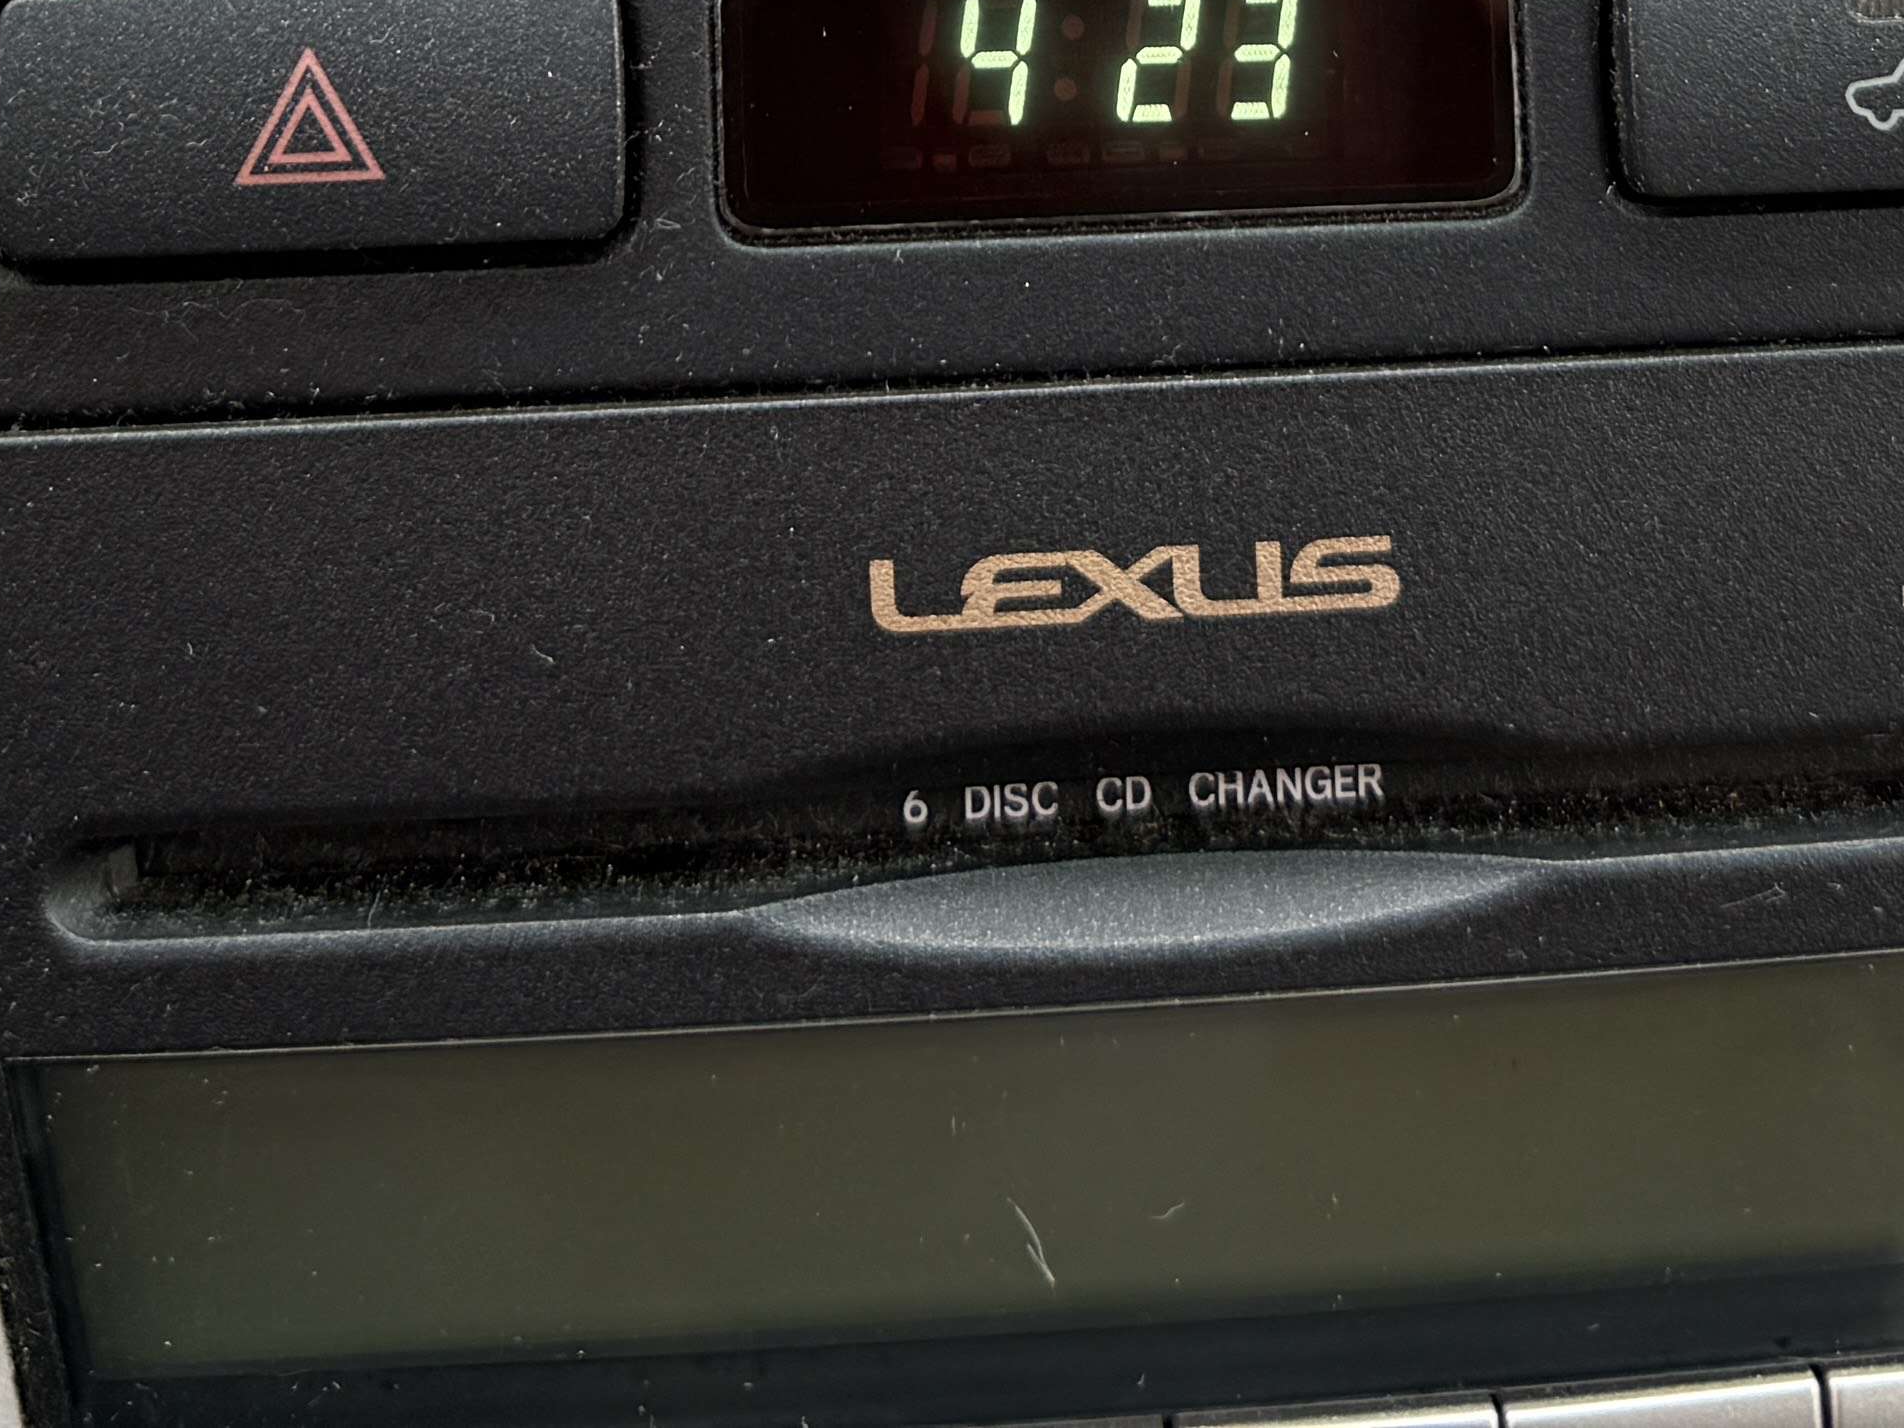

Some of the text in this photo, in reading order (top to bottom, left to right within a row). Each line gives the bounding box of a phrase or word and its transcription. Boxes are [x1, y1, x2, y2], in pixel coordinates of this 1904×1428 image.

[869, 535, 1400, 633] LEXUS
[903, 763, 1384, 824] 6 DISC CD CHANGER
